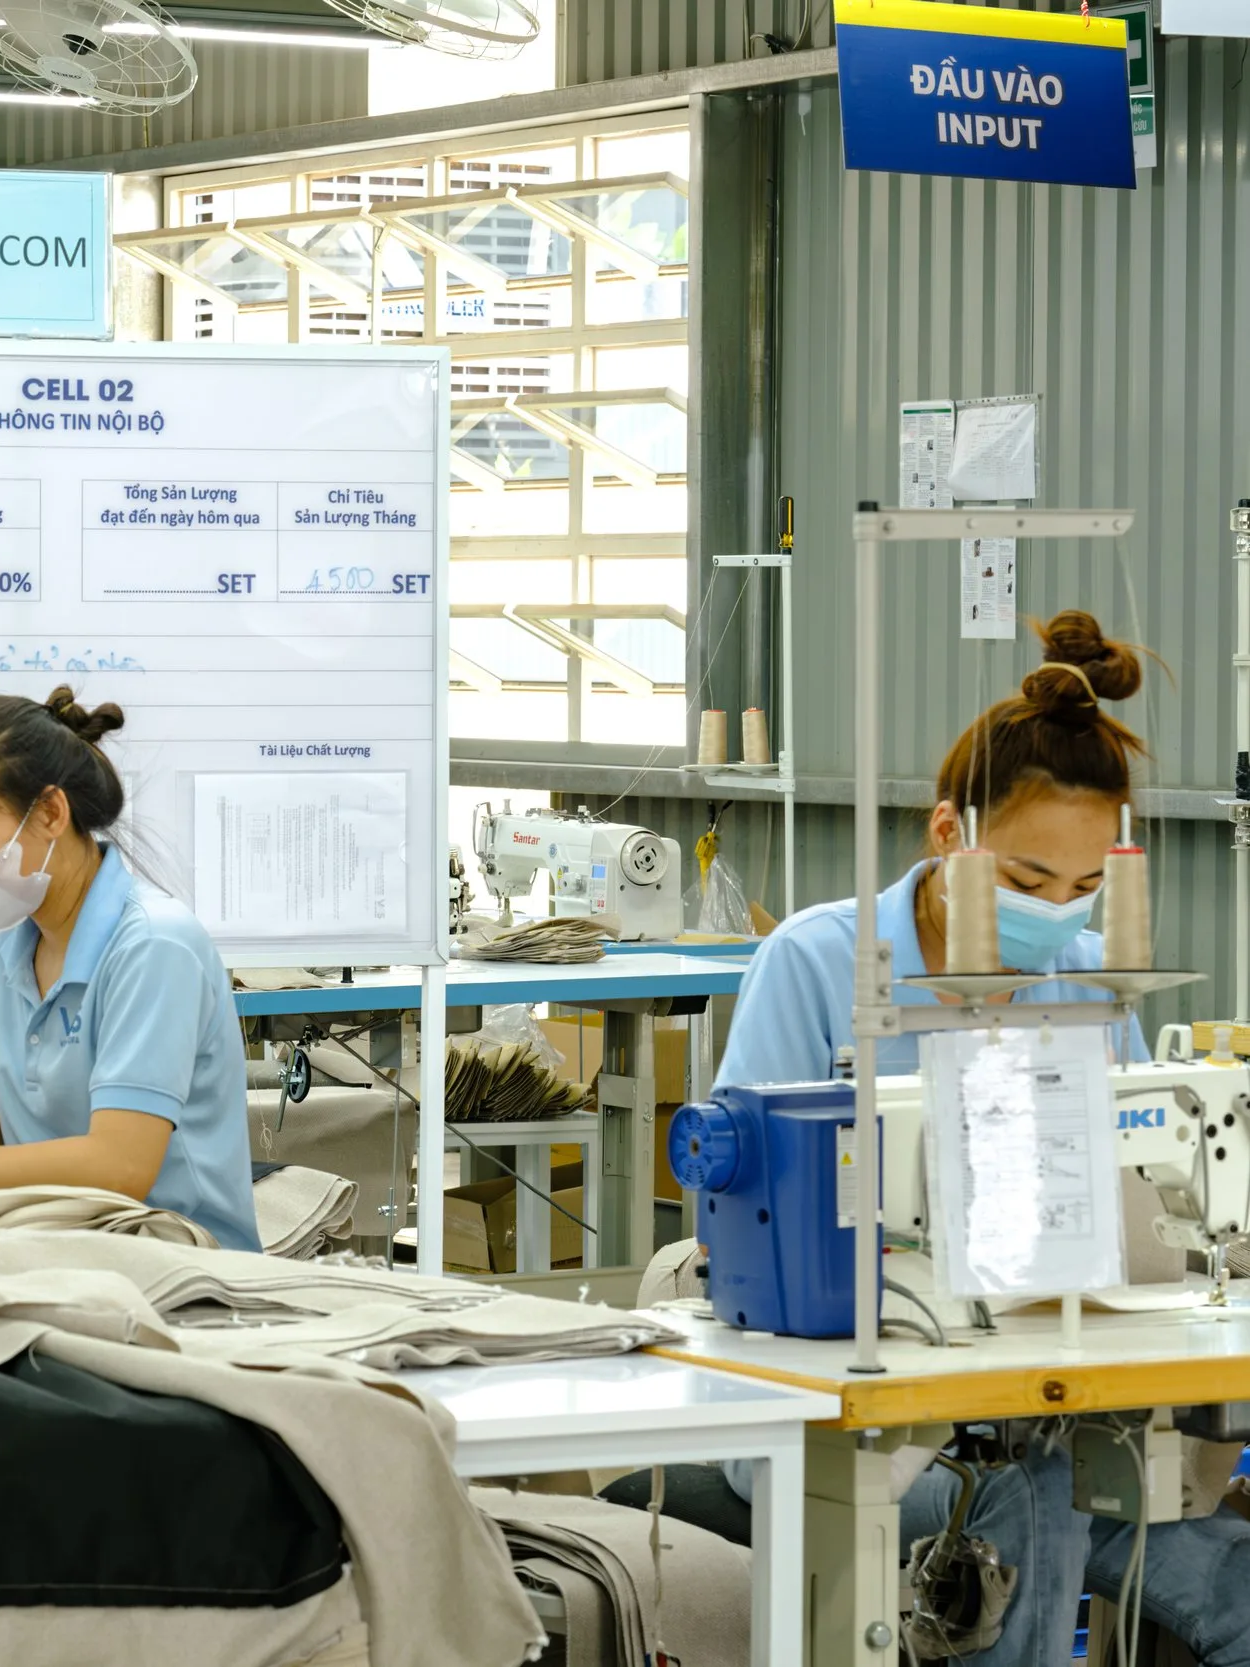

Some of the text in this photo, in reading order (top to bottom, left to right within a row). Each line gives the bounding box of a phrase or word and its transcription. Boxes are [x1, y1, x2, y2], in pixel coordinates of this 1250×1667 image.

[909, 55, 1064, 106] ĐẦU VÀO
[937, 112, 1043, 150] INPUT
[22, 378, 134, 402] CELL 02
[60, 413, 91, 430] TIN
[98, 410, 131, 434] NỘI
[138, 410, 165, 435] BỘ
[124, 483, 237, 503] Tổng Sản Lượng
[328, 487, 384, 504] Chỉ Tiêu
[100, 506, 260, 529] đạt đến ngày hôm qua
[294, 508, 416, 528] Sản Lượng Tháng
[217, 573, 256, 593] SET
[305, 566, 375, 592] 4500
[391, 573, 431, 594] SET
[259, 742, 371, 760] Tài Liệu Chất Lượng
[513, 831, 541, 846] Santar
